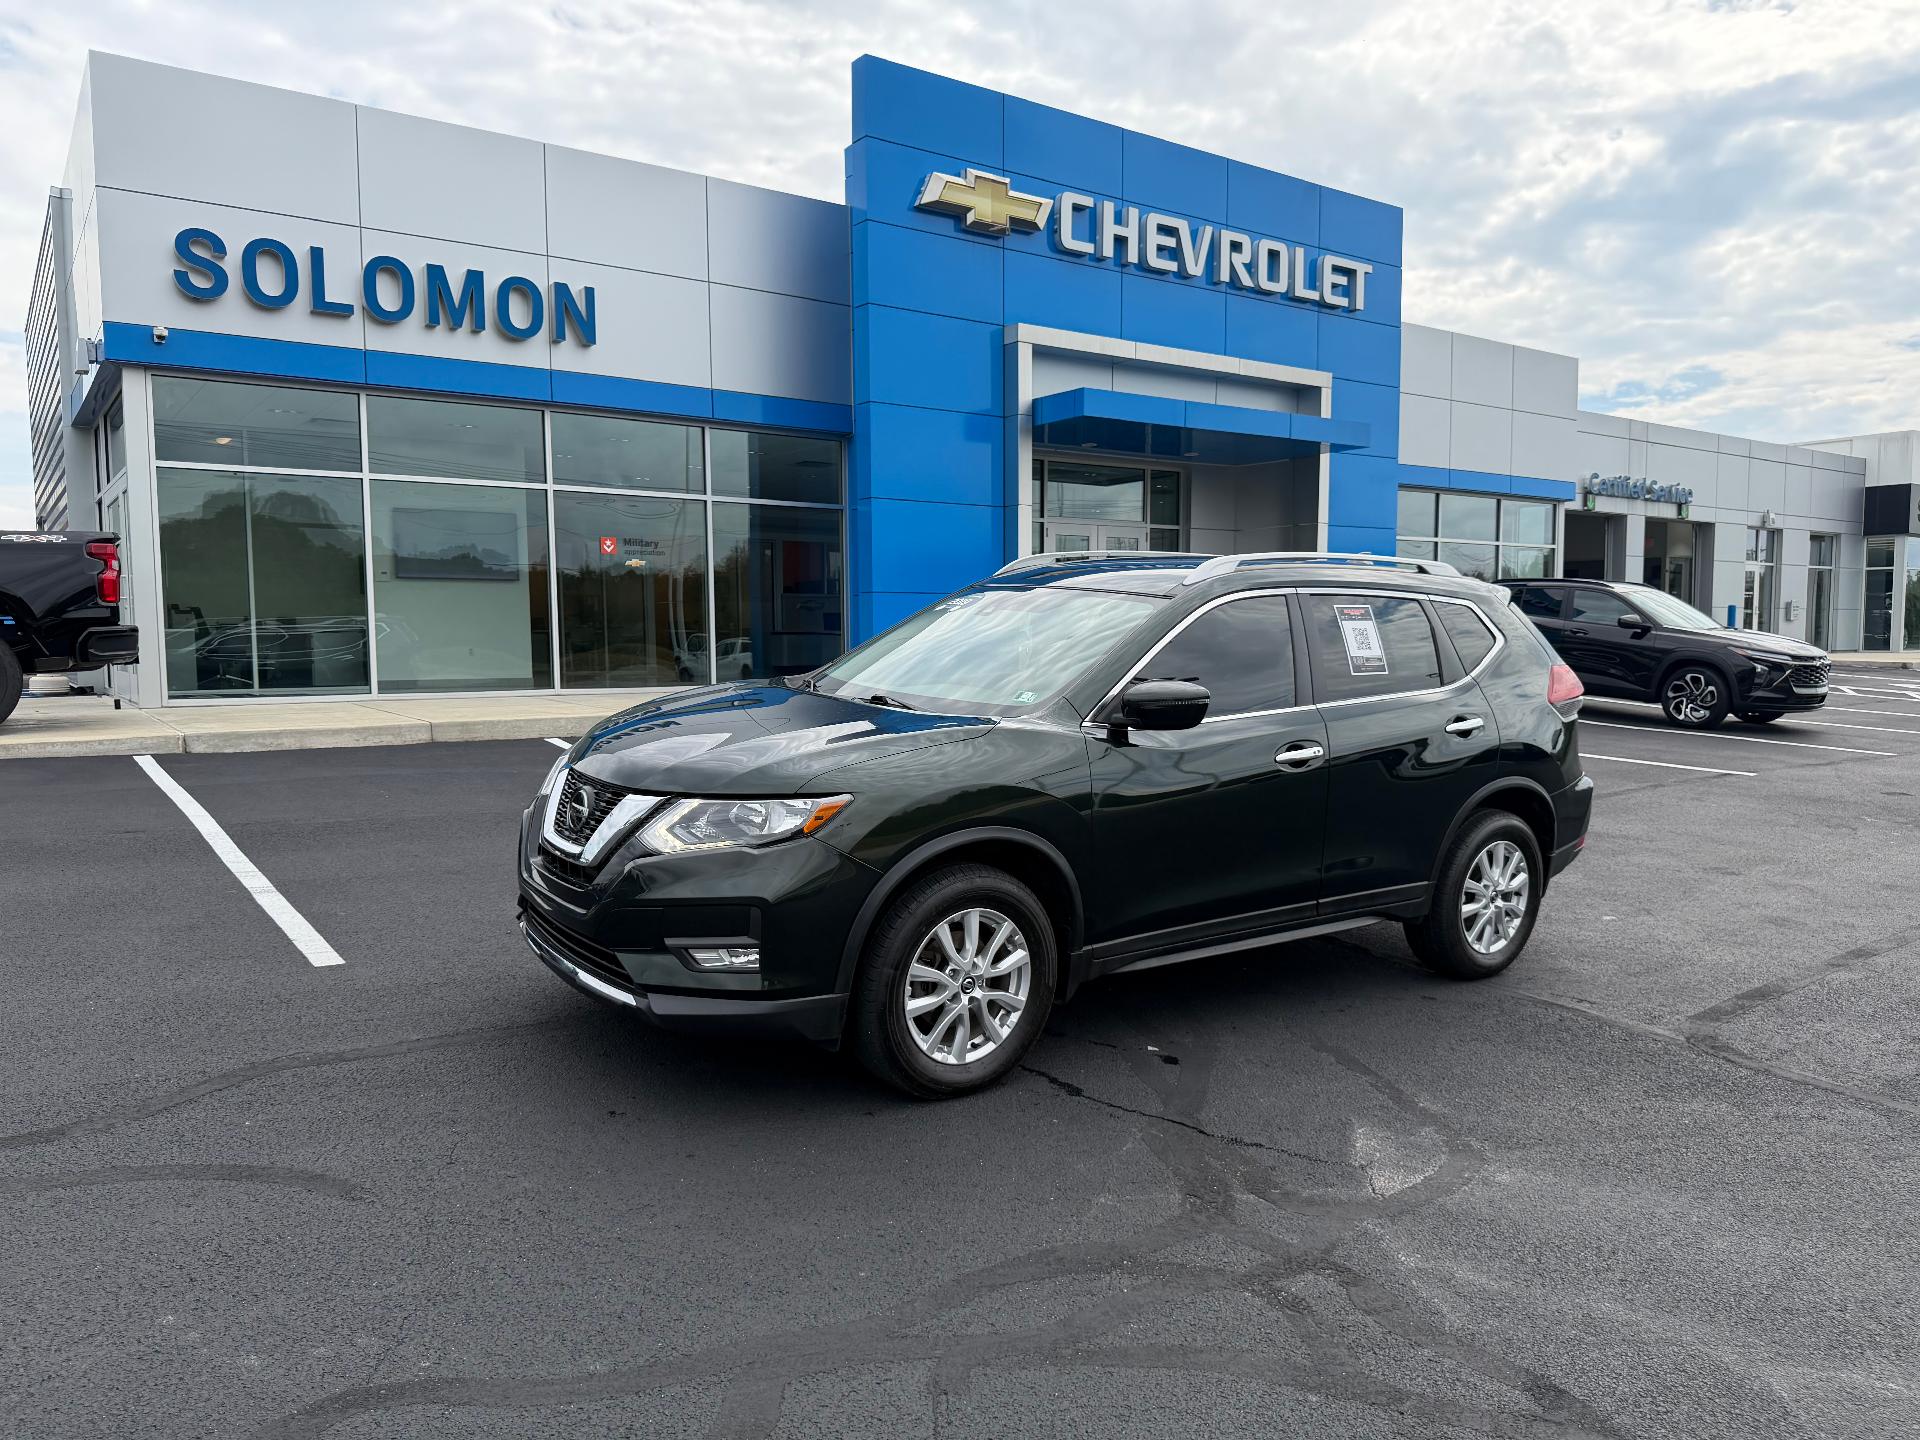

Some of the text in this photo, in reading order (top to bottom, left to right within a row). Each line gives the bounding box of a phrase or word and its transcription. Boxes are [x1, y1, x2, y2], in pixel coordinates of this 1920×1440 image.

[173, 227, 597, 347] SOLOMON
[1055, 191, 1373, 311] CHEVROLET
[1589, 472, 1693, 504] Certified Service
[624, 538, 659, 549] Military
